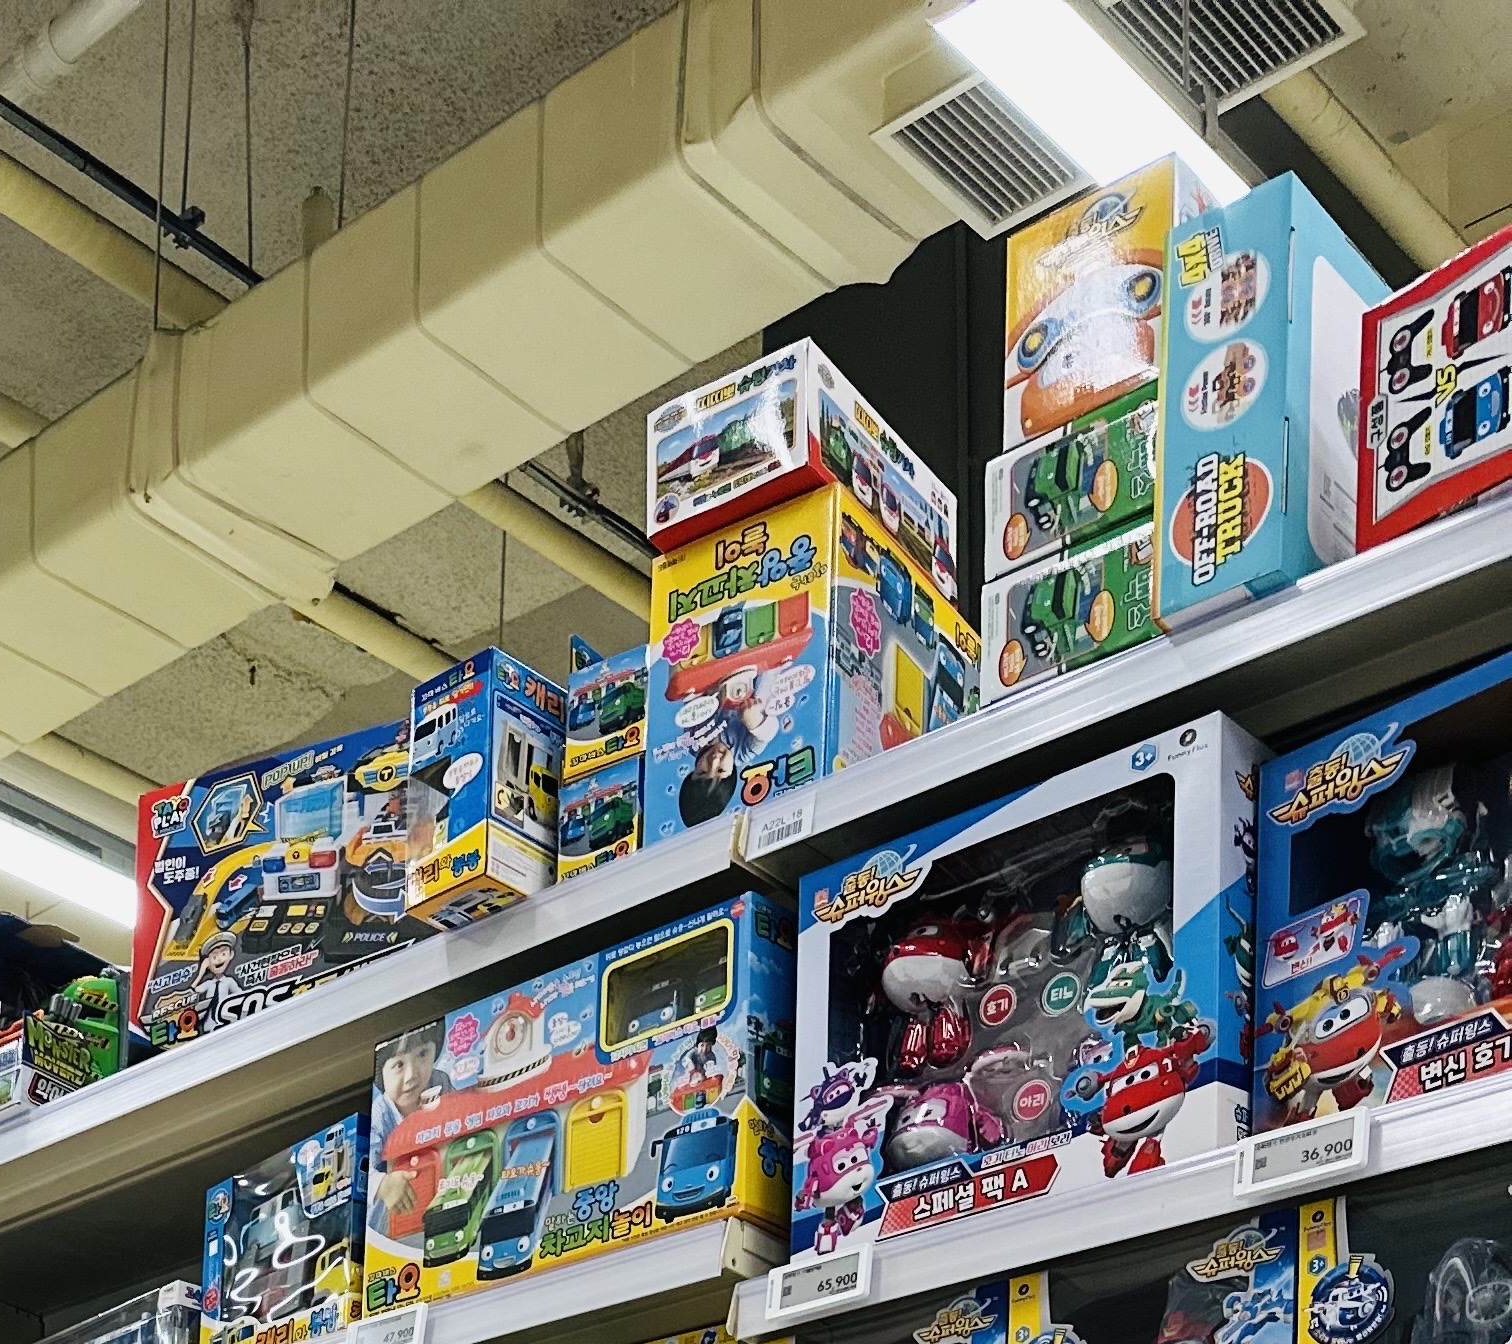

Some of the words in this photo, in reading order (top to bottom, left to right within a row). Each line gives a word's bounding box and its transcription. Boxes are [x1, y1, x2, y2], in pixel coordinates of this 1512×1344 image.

[1192, 452, 1219, 586] OFF-ROAD
[1215, 451, 1245, 566] TRUCK
[715, 522, 769, 571] 놀이
[669, 535, 817, 624] 중앙차고지
[605, 726, 641, 752] 타요
[741, 745, 816, 807] 타요
[1270, 749, 1407, 824] 슈퍼윙스
[1306, 751, 1349, 789] 출동!
[814, 868, 922, 923] 슈퍼윙스
[354, 932, 385, 942] POLICE
[986, 996, 1010, 1016] 호기
[1050, 985, 1076, 1003] 티노
[150, 1009, 198, 1046] 타요
[1402, 1040, 1434, 1063] 출동!
[1436, 1020, 1493, 1051] 슈퍼윙스
[1420, 1056, 1466, 1091] 변신
[1018, 1090, 1046, 1109] 아리
[1301, 1139, 1353, 1163] 36,900
[574, 1181, 619, 1221] 중앙
[913, 1184, 976, 1222] 스페셜
[980, 1177, 1006, 1202] 팩
[1010, 1169, 1029, 1192] A
[1192, 1246, 1284, 1277] 슈퍼윙스
[367, 1263, 420, 1311] 타요
[816, 1270, 858, 1294] 65,900
[384, 1325, 414, 1343] 47,900
[917, 1316, 994, 1343] 슈퍼윙스
